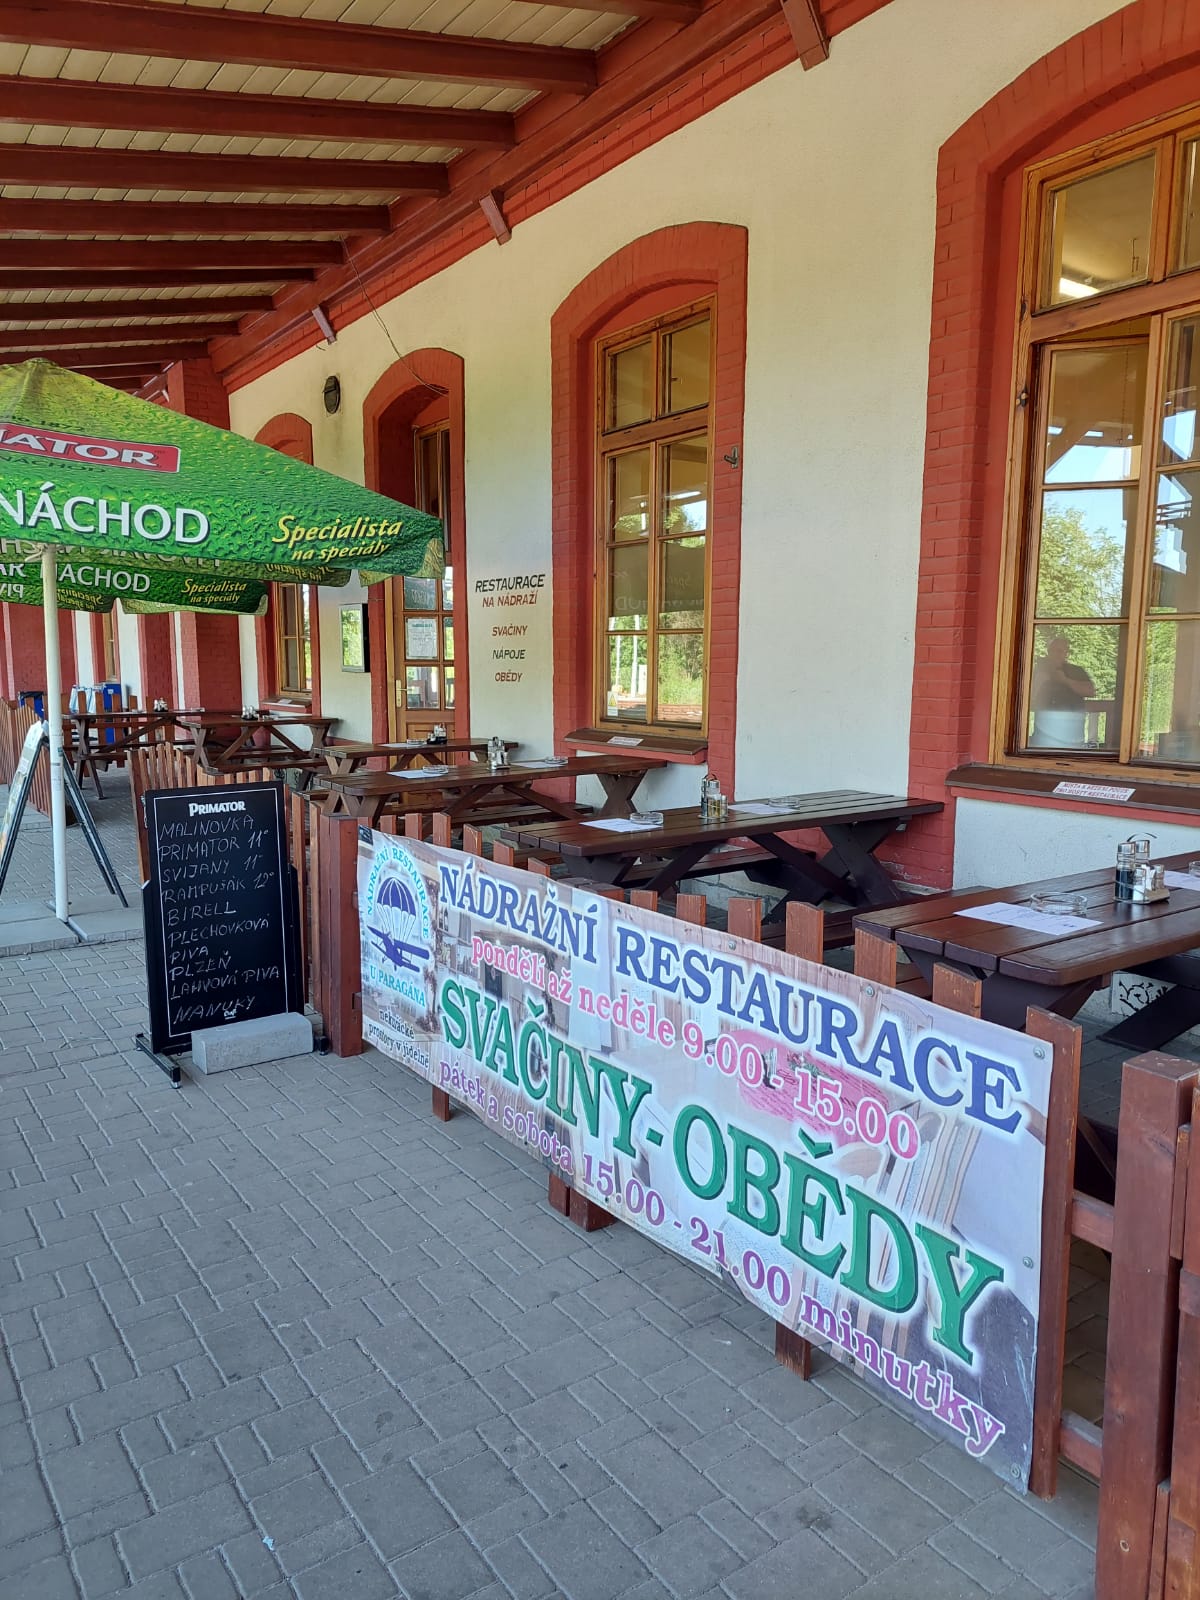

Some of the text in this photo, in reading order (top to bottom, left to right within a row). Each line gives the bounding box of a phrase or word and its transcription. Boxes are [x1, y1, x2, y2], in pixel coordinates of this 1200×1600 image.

[0, 429, 158, 467] ATOR
[272, 515, 403, 548] Specialista
[292, 540, 391, 562] na speciály
[181, 579, 247, 595] Specialista
[475, 574, 546, 592] RESTAURACE
[190, 593, 241, 606] na speciály
[482, 590, 539, 608] NA NÁDRAŽÍ
[492, 623, 528, 636] SVAČINY
[492, 646, 526, 659] NÁPOJE
[494, 669, 523, 682] OBĚDY
[189, 801, 246, 817] PRIMATOR
[160, 815, 253, 840] MALINOVKA
[159, 837, 240, 862] PRIMATOR
[162, 860, 229, 883] SVIJANY
[392, 848, 429, 938] RESTAURACE
[168, 901, 237, 927] BIRELL
[169, 946, 209, 965] PIVA
[242, 966, 279, 983] PIVA
[370, 965, 426, 1007] U PARAGÁNA
[440, 858, 1023, 1134] NÁDRAŽNÍ RESTAURACE
[173, 995, 255, 1024] NANUKY
[369, 1023, 395, 1051] prostory
[396, 1041, 401, 1050] v
[472, 938, 546, 989] pondělí
[549, 970, 572, 1003] až
[578, 987, 674, 1046] neděle
[683, 1022, 763, 1086] 9.00
[795, 1069, 919, 1159] 15.00
[439, 1061, 485, 1109] pátek
[488, 1096, 498, 1121] a
[504, 1106, 573, 1175] sobota
[583, 1154, 665, 1226] 15.00
[690, 1217, 791, 1307] 21.00
[801, 1294, 1005, 1457] minutky
